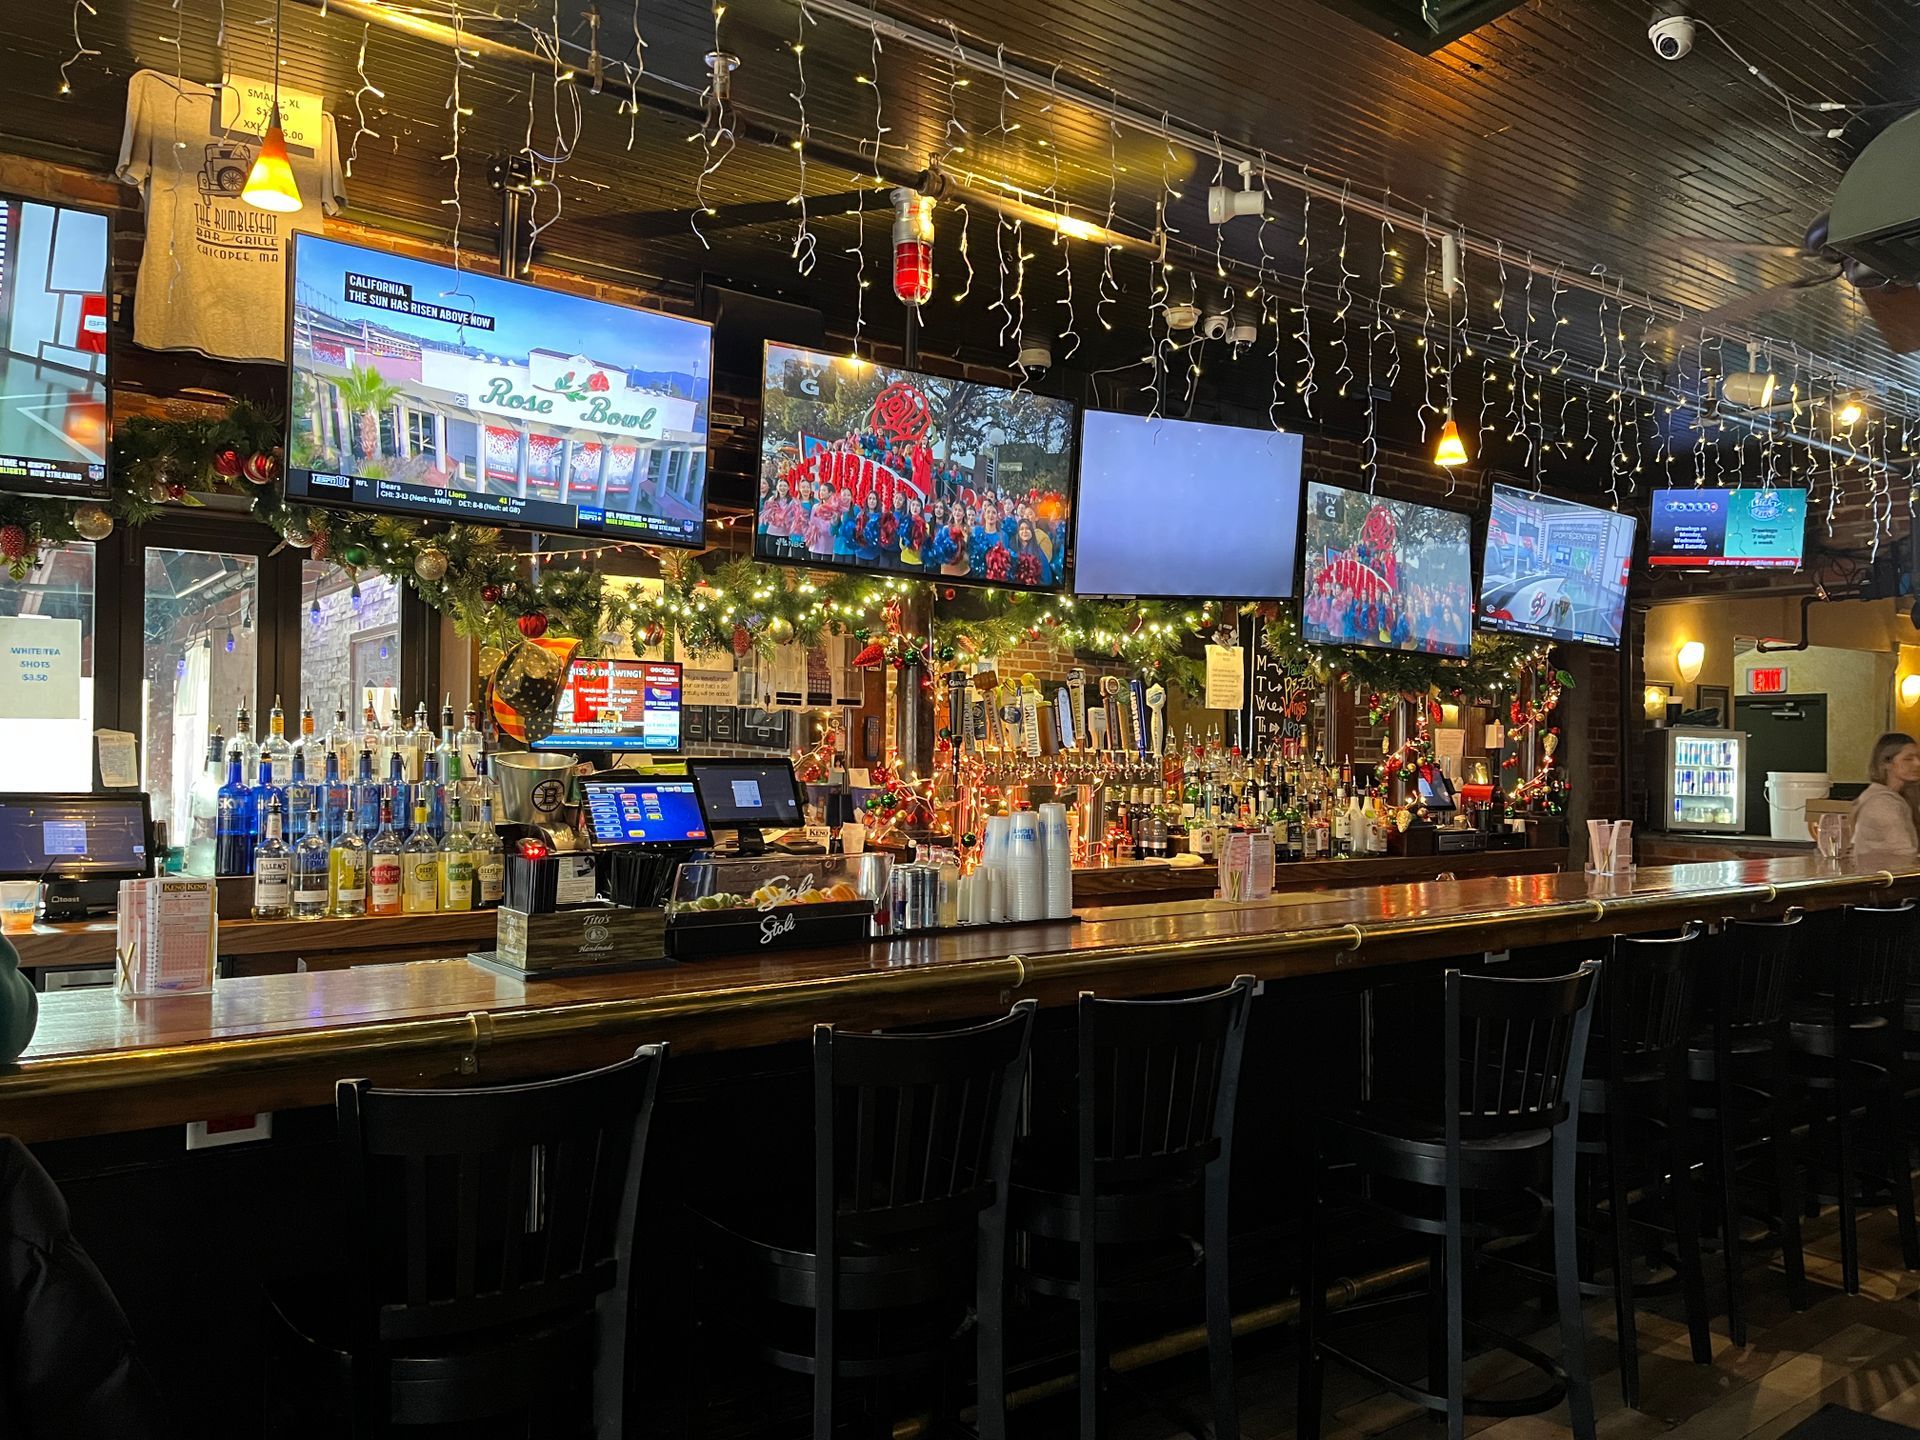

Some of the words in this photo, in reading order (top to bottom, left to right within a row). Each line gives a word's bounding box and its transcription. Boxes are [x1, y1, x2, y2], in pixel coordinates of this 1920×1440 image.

[289, 99, 300, 109] XL
[243, 119, 262, 132] XXL
[194, 203, 211, 228] THE
[214, 209, 278, 236] RUMBLESEAT
[196, 227, 221, 242] BAR
[235, 236, 279, 247] GRILLE
[259, 253, 279, 263] MA
[349, 290, 367, 305] THE
[369, 294, 388, 308] SUN
[391, 298, 409, 312] HAS
[411, 303, 438, 318] RISEN
[440, 309, 469, 324] ABOVE
[471, 314, 491, 328] NOW
[802, 367, 821, 378] TV
[799, 379, 820, 396] G
[479, 377, 554, 414] Rose
[580, 397, 657, 430] Bowl
[46, 471, 82, 481] STREAMING
[355, 479, 368, 487] NFL
[380, 482, 401, 491] Bears
[434, 488, 443, 496] 10
[380, 490, 394, 499] CHI:
[395, 492, 409, 501] 3-13
[437, 498, 452, 506] MIN)
[448, 491, 467, 499] Lions
[499, 498, 507, 506] 41
[512, 499, 526, 507] Final
[458, 500, 472, 508] DET:
[1325, 496, 1337, 504] TV
[1325, 505, 1336, 518] G
[1553, 531, 1597, 542] SPORTSCENTER
[788, 540, 805, 548] NBC
[10, 647, 43, 655] WHITE
[43, 648, 61, 656] TEA
[19, 660, 50, 668] SHOTS
[1256, 655, 1267, 671] M
[22, 673, 48, 682] $3.50
[598, 669, 642, 678] DRAWING!
[1753, 669, 1781, 691] EXIT
[1256, 676, 1267, 692] T
[1284, 675, 1316, 704] Pizza
[1255, 695, 1268, 711] W
[1281, 690, 1307, 722] Wings
[1255, 716, 1266, 732] Th
[1257, 735, 1267, 752] F
[542, 785, 557, 804] B
[164, 883, 186, 892] KENO
[187, 883, 207, 891] KENO
[757, 873, 814, 913] Stoli
[583, 914, 612, 926] Tito's
[760, 913, 796, 944] Stoli
[578, 943, 615, 953] Handmade
